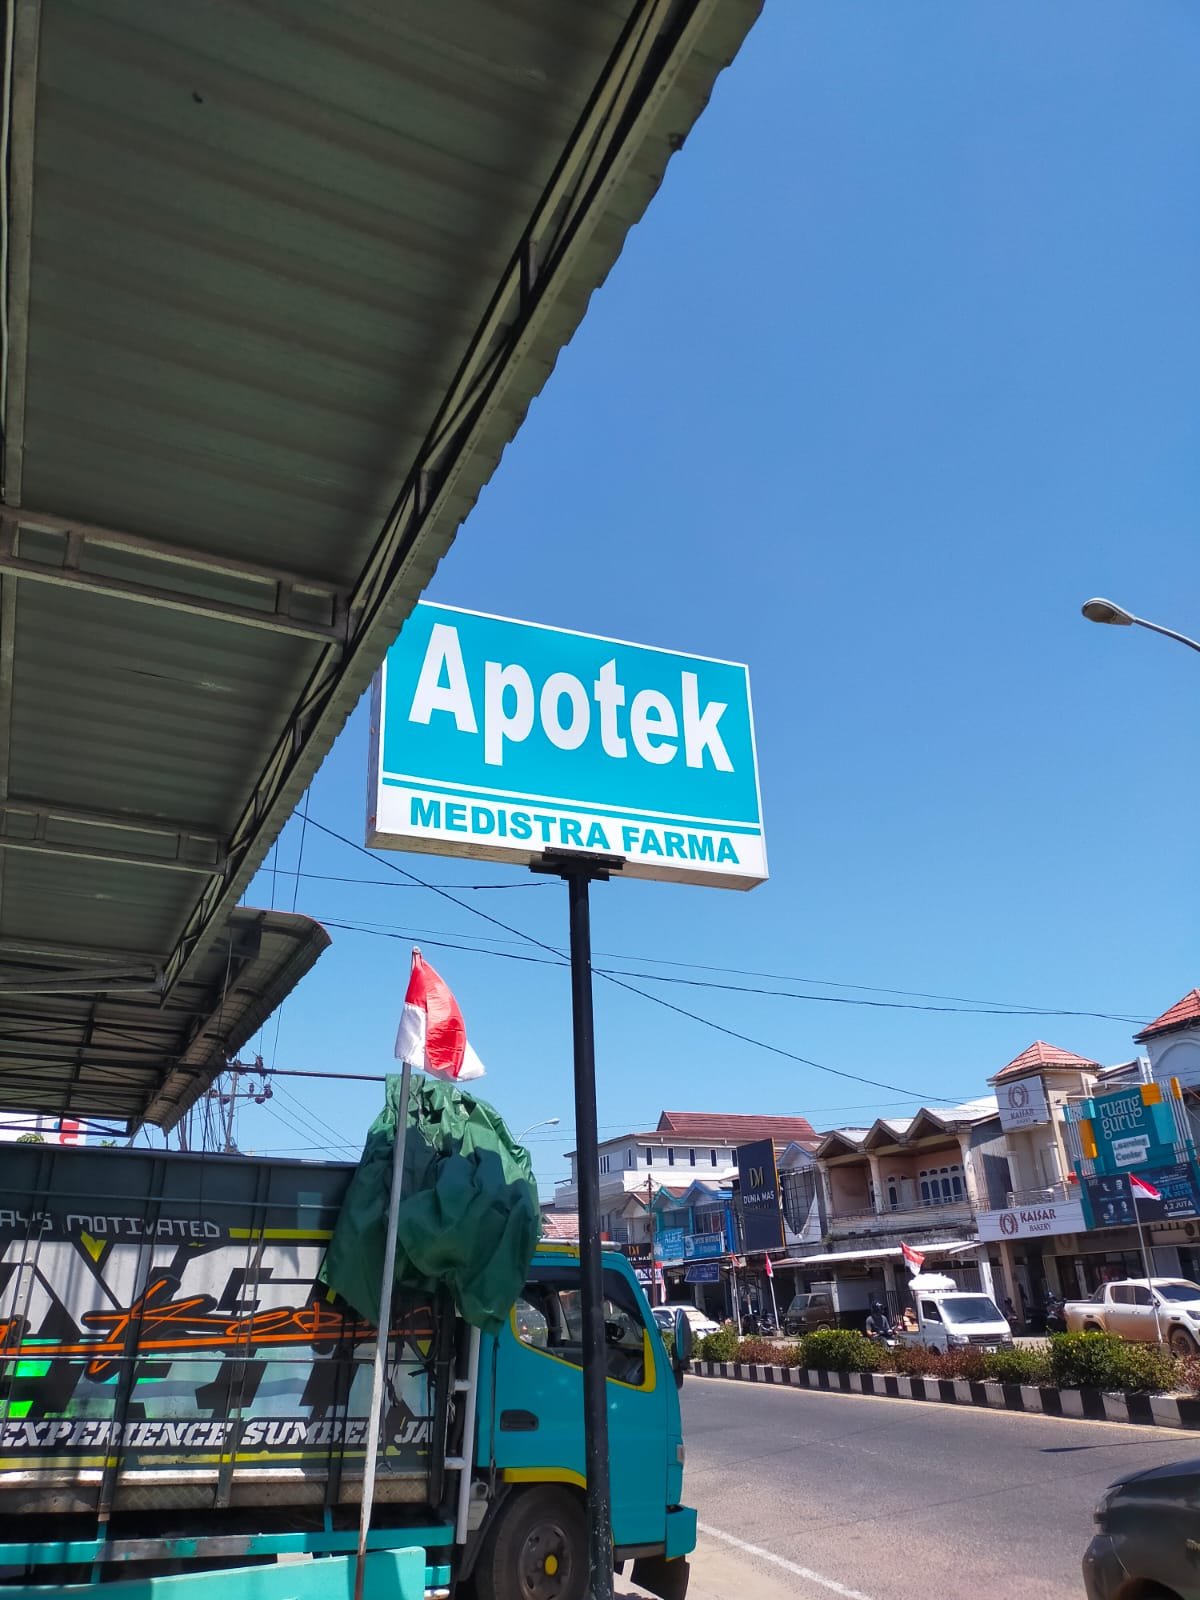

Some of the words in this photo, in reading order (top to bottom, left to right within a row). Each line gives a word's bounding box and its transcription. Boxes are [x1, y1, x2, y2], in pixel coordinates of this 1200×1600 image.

[408, 622, 735, 773] Apotek
[410, 797, 610, 849] MEDISTRA
[622, 826, 740, 865] FARMA
[1099, 1094, 1143, 1119] ruang
[743, 1194, 761, 1205] DUNIA
[761, 1190, 775, 1201] MAS
[1020, 1208, 1056, 1223] KAISAR
[0, 1421, 233, 1447] EXPERIENCE
